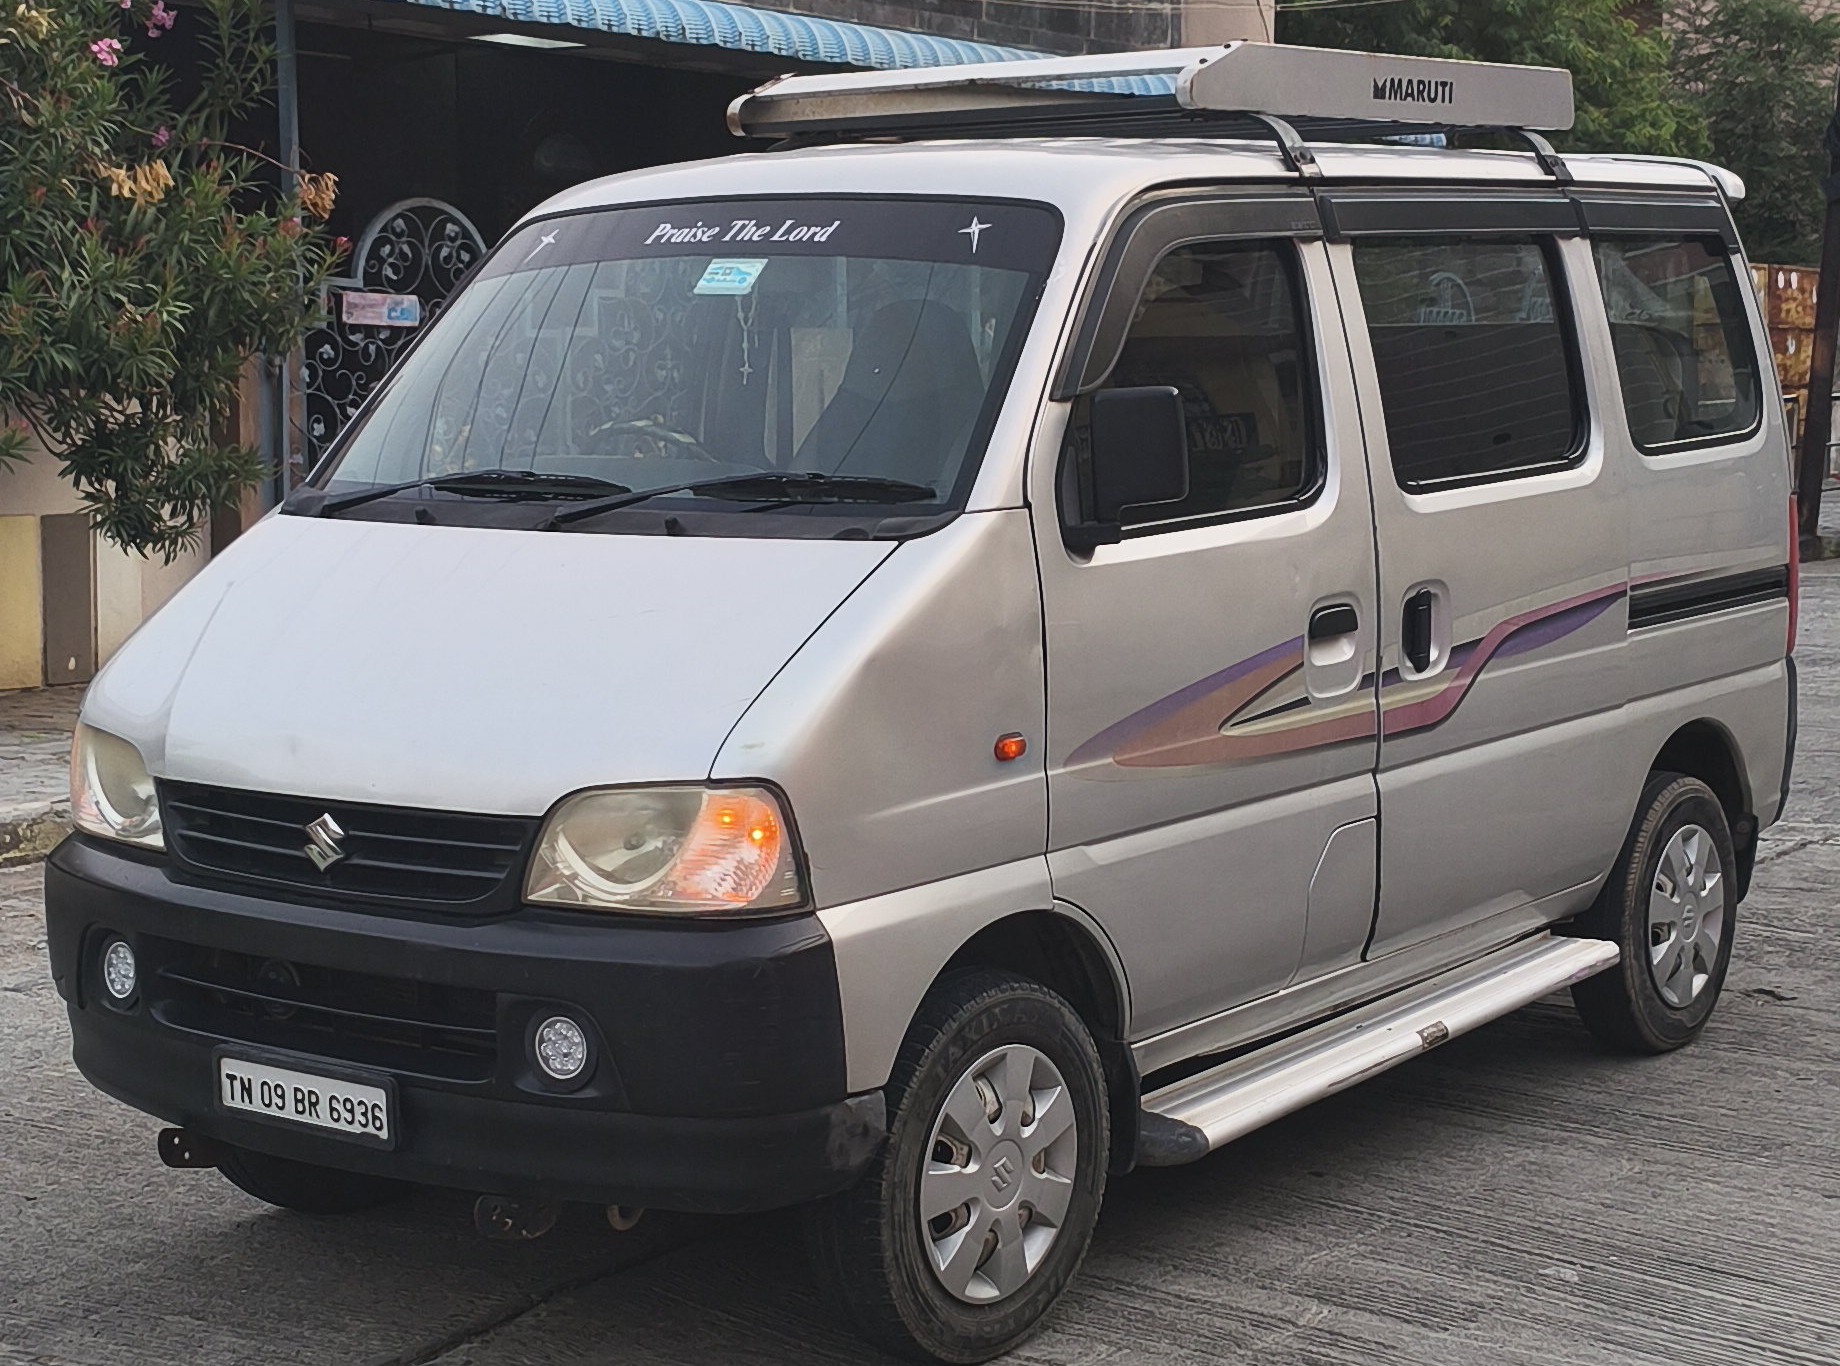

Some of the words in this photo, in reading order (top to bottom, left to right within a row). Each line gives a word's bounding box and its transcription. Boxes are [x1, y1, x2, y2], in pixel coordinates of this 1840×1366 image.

[1388, 77, 1454, 104] MARUTI
[644, 221, 720, 245] Praise
[721, 220, 771, 242] The
[770, 219, 841, 242] Lord
[225, 1072, 253, 1105] TN
[260, 1080, 286, 1111] 09
[293, 1086, 321, 1120] BR
[328, 1094, 384, 1132] 6936
